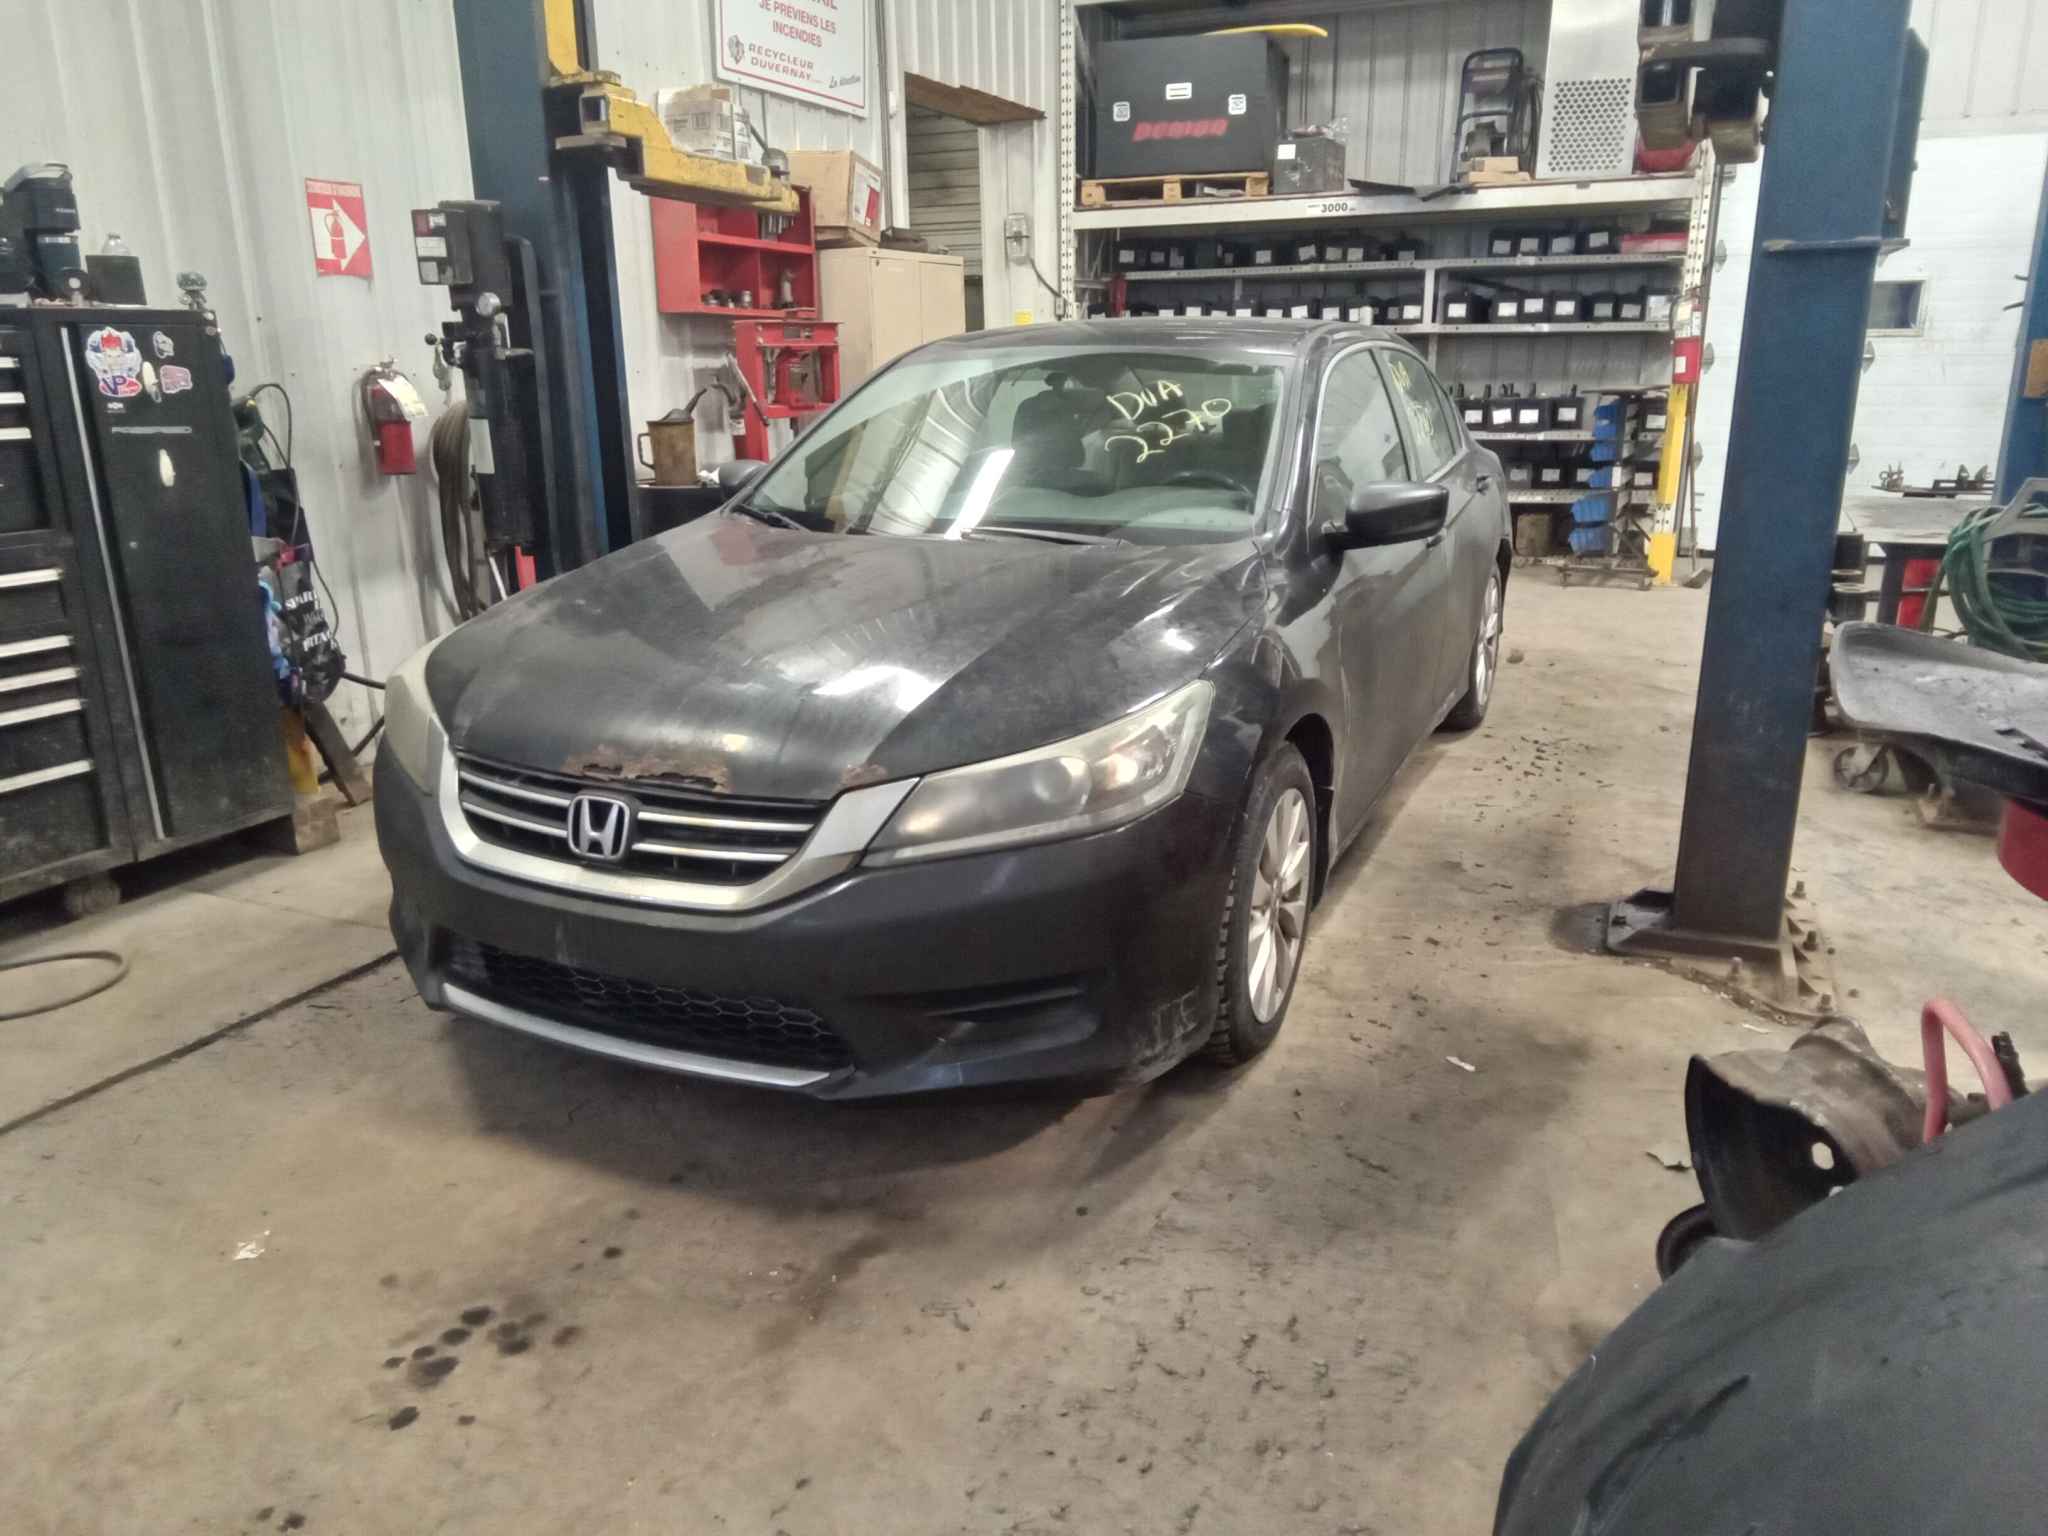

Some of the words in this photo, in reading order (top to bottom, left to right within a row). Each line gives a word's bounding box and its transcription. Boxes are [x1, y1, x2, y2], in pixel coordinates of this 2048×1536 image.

[772, 20, 823, 47] INCENDIES
[820, 18, 837, 34] LES
[749, 43, 814, 70] RECYCLEUR
[751, 57, 812, 80] DUVERNAY
[1320, 202, 1349, 213] 3000
[1104, 398, 1232, 464] 2270
